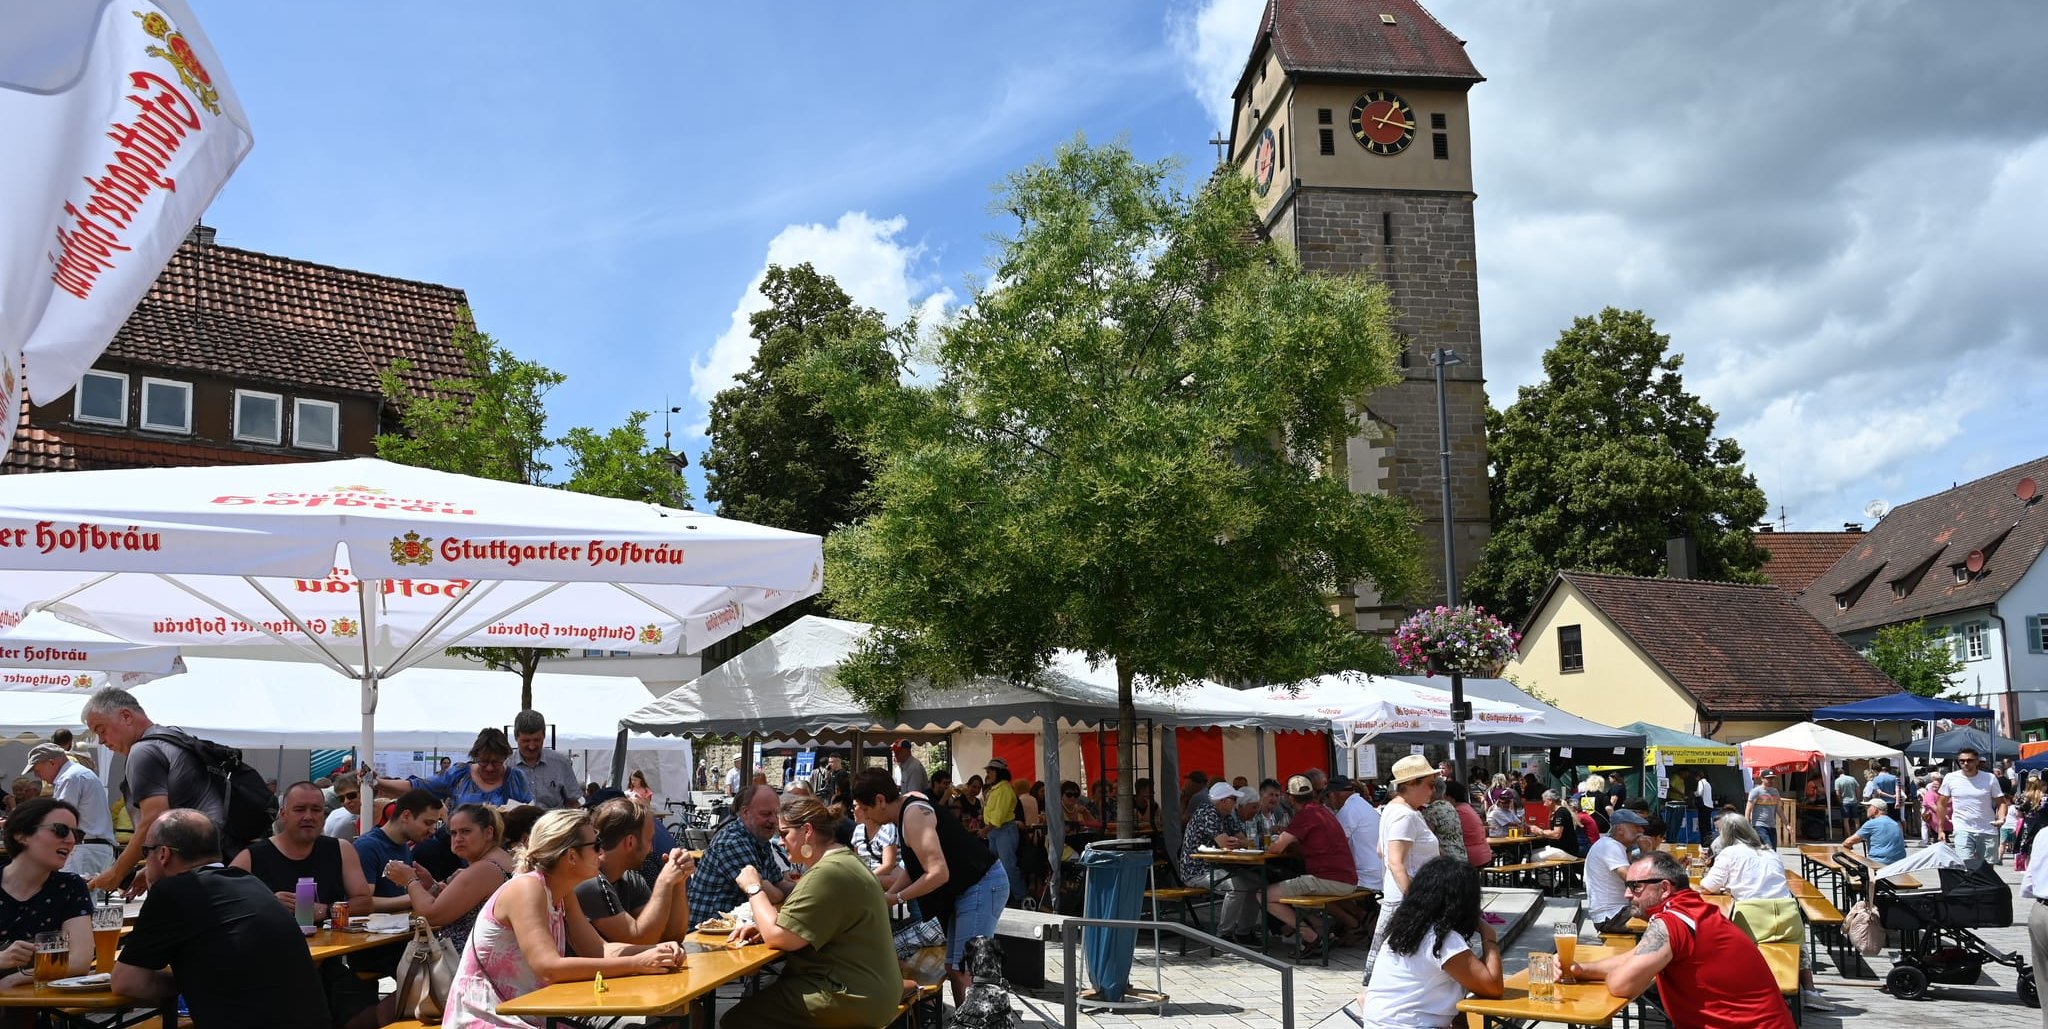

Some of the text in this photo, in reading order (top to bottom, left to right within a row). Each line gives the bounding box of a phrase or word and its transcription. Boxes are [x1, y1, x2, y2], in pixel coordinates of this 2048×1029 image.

[35, 520, 162, 555] Hofbräu
[440, 536, 684, 567] Stuttgarter Hofbräu
[24, 645, 88, 663] Hofbräu
